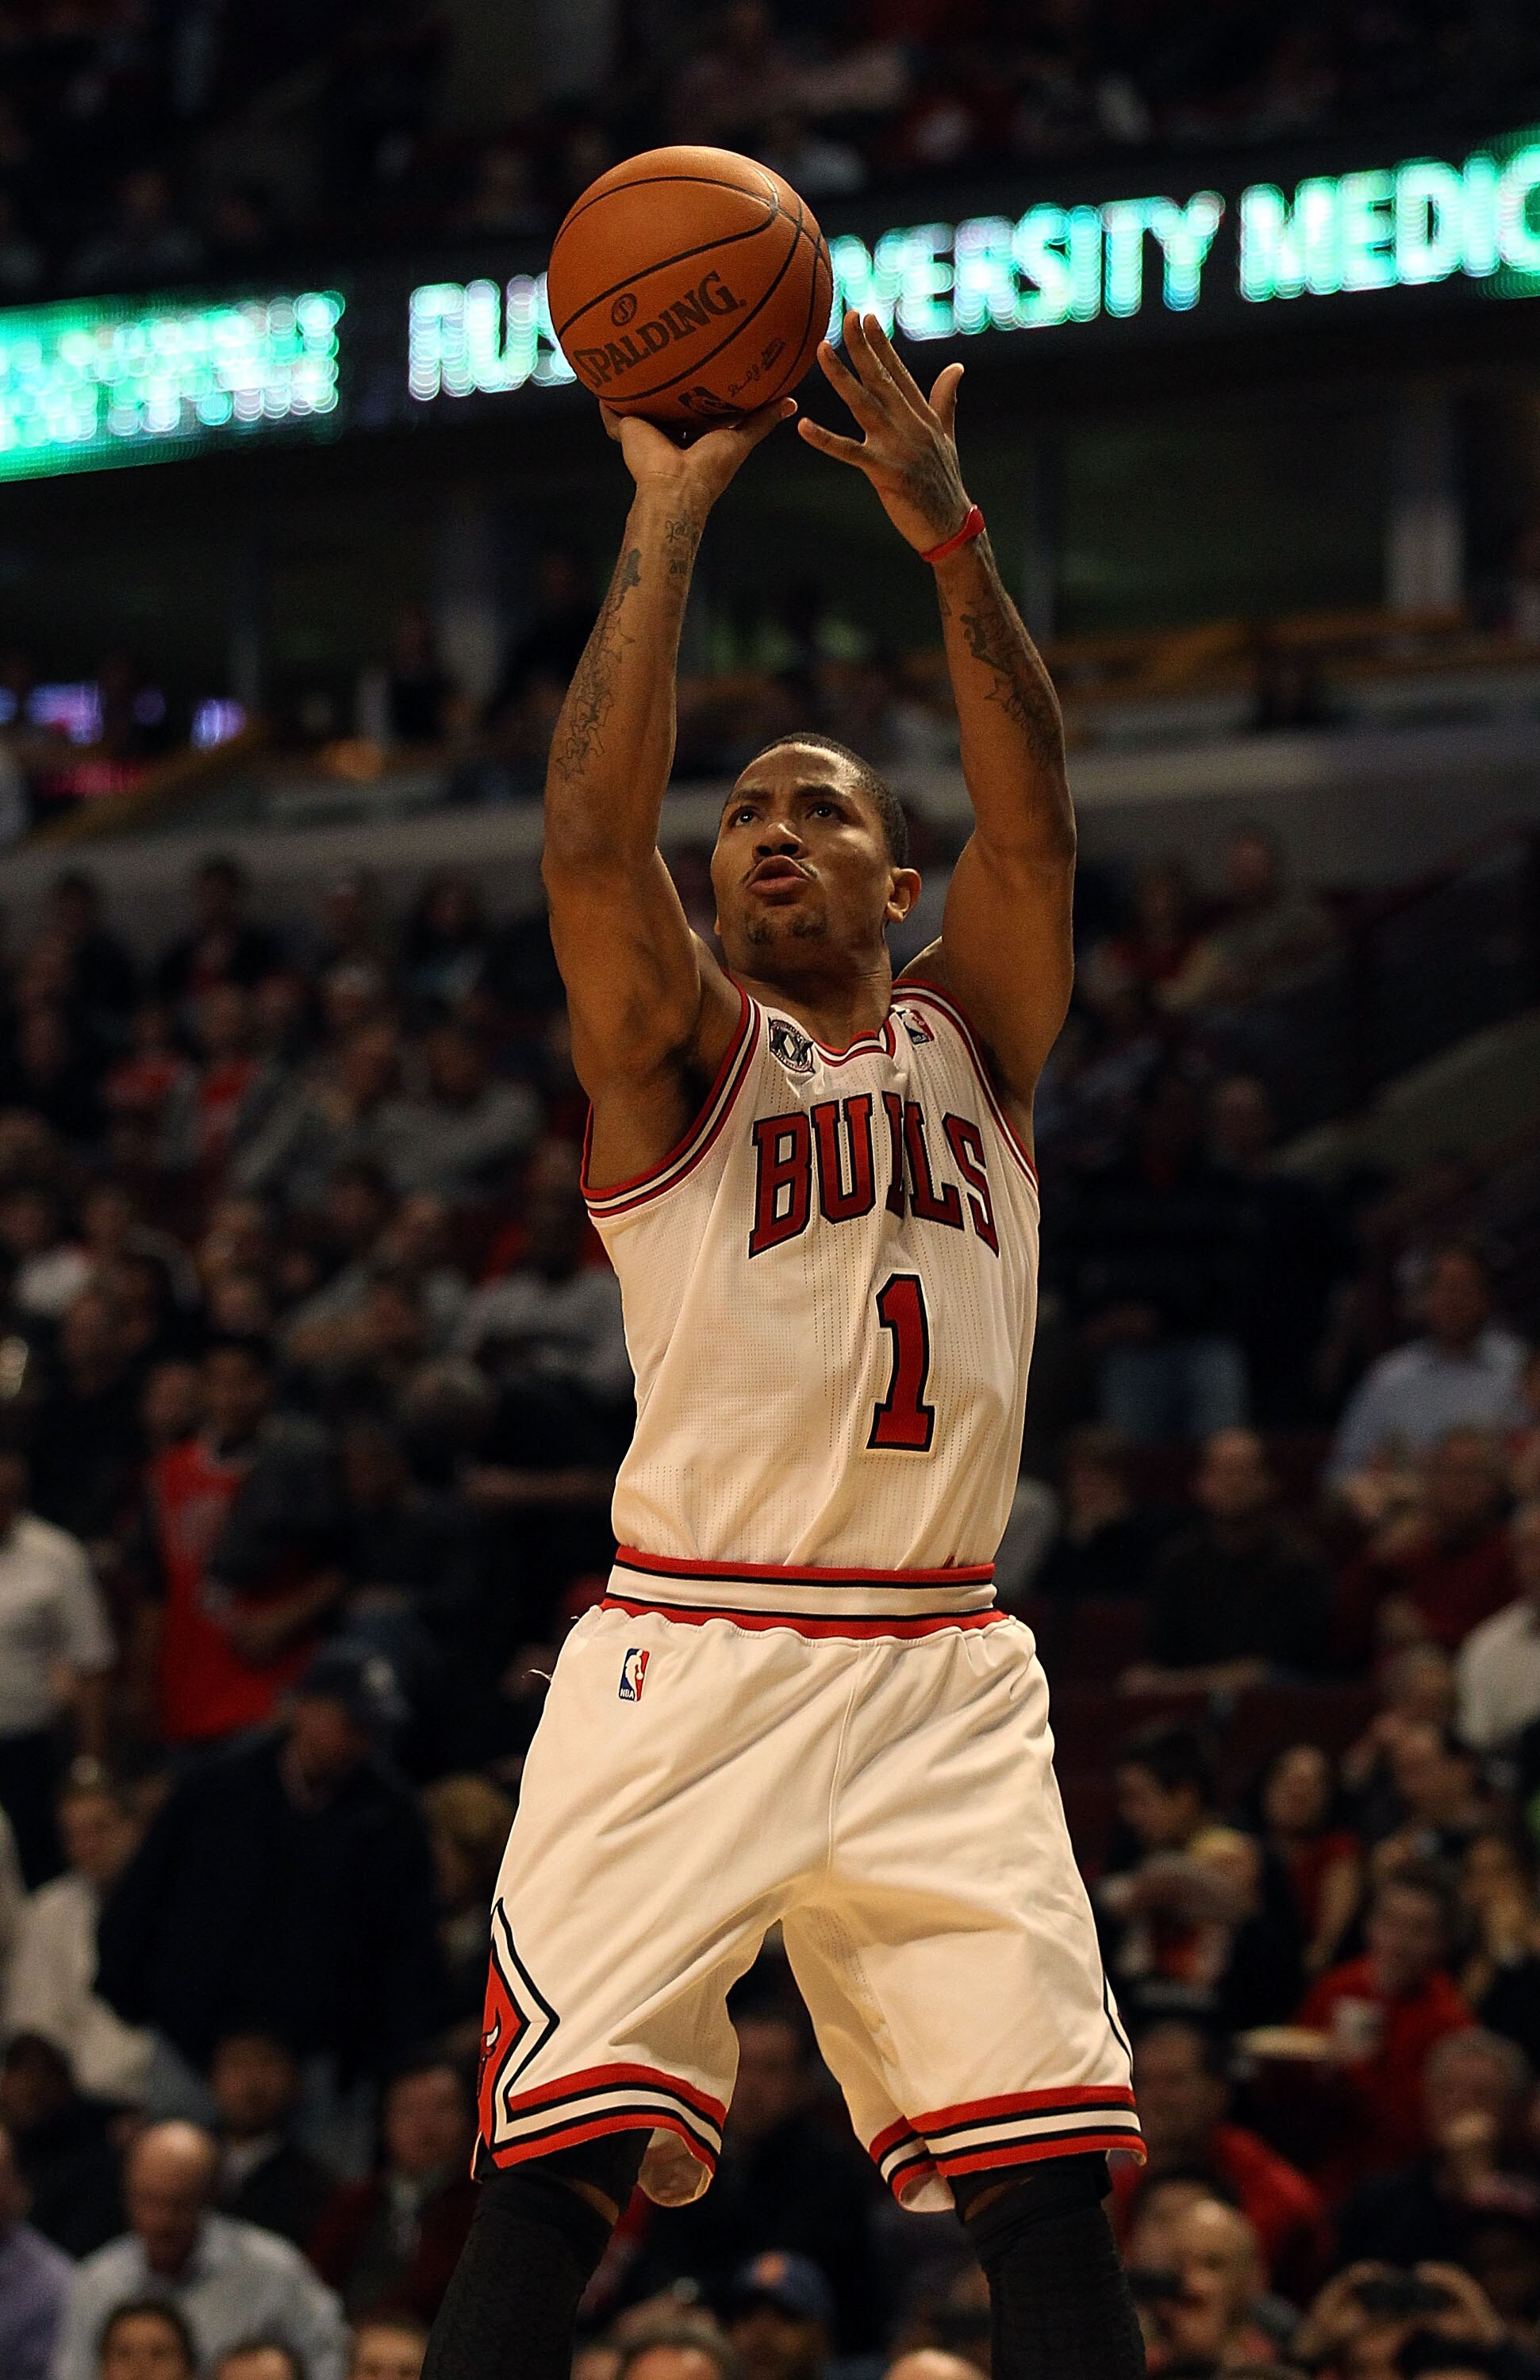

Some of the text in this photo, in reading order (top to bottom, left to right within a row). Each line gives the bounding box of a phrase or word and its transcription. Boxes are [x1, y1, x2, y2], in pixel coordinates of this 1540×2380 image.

[573, 271, 741, 388] SPALDING
[748, 1090, 1000, 1260] BULLS
[866, 1273, 936, 1453] 1
